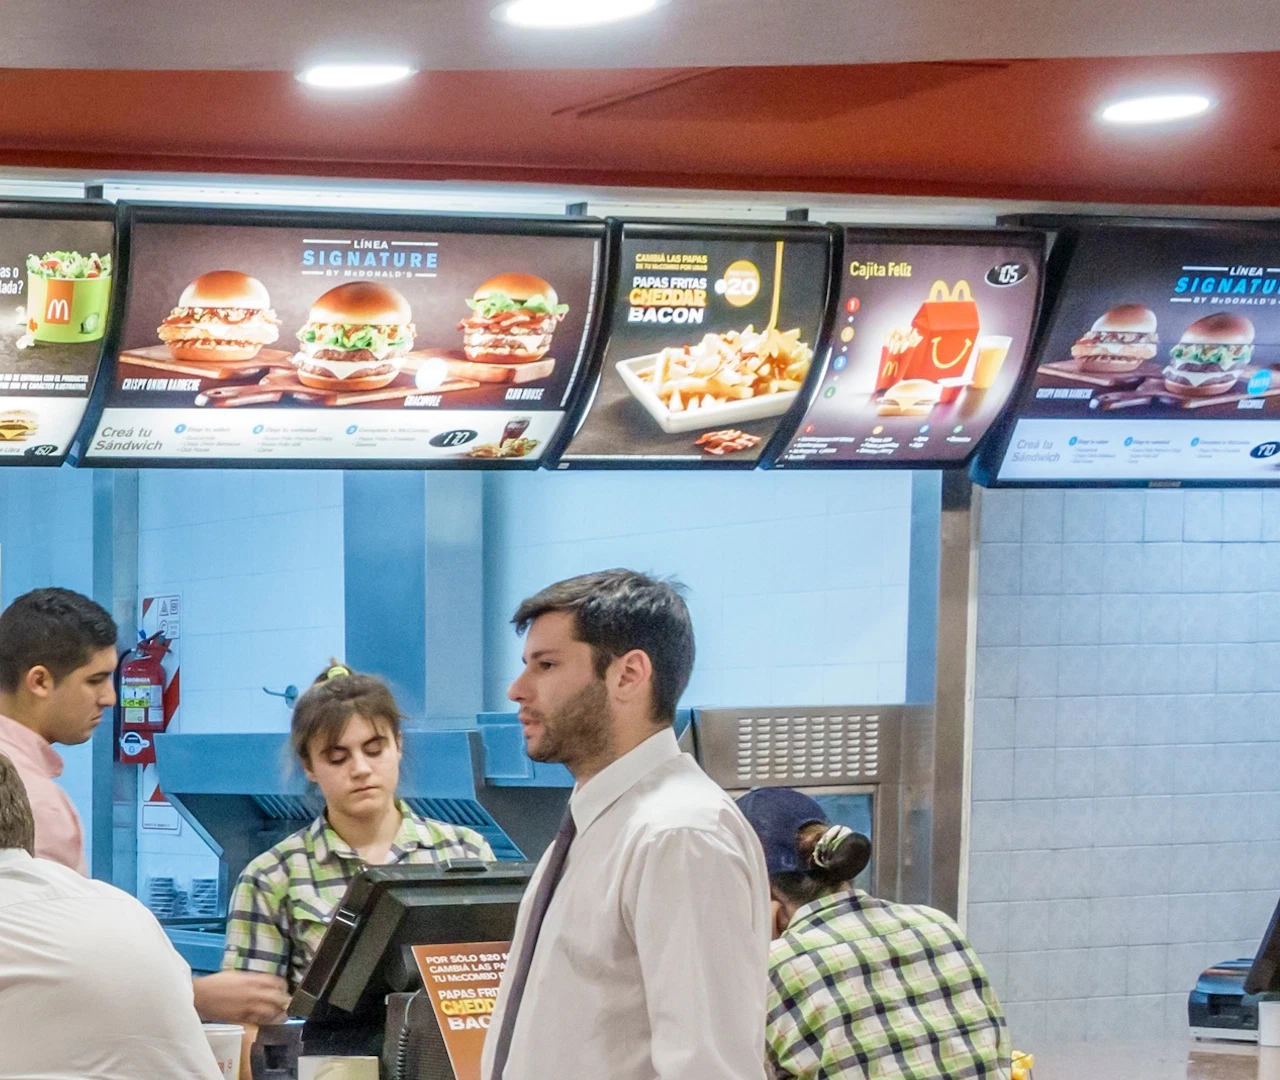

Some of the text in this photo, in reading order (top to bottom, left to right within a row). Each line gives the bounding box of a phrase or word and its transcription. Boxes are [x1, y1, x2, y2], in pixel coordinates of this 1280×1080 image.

[353, 239, 389, 249] LÍNEA
[302, 250, 438, 268] SIGNATURE
[667, 255, 681, 263] LAS
[682, 255, 707, 263] PAPAS
[344, 270, 412, 278] McDONALD'S
[850, 261, 912, 280] Cajita Feliz
[1229, 265, 1263, 276] LÍNEA
[633, 276, 707, 289] PAPAS FRITAS
[1174, 276, 1280, 294] SIGNATU
[629, 288, 707, 307] CHEDDAR
[1193, 296, 1207, 304] BY
[627, 307, 704, 324] BACON
[122, 378, 146, 391] CRISPY
[521, 388, 544, 400] HOUSE
[101, 424, 153, 438] Creá tu
[94, 439, 163, 451] Sándwich
[1011, 452, 1060, 462] Sándwich
[426, 954, 500, 964] POR SÓLO $20
[429, 963, 492, 973] CAMBIÁ LAS
[447, 972, 498, 982] McCOMBO
[438, 987, 499, 999] PAPAS FRIT
[441, 998, 496, 1015] CHEDD
[448, 1015, 491, 1030] BAC
